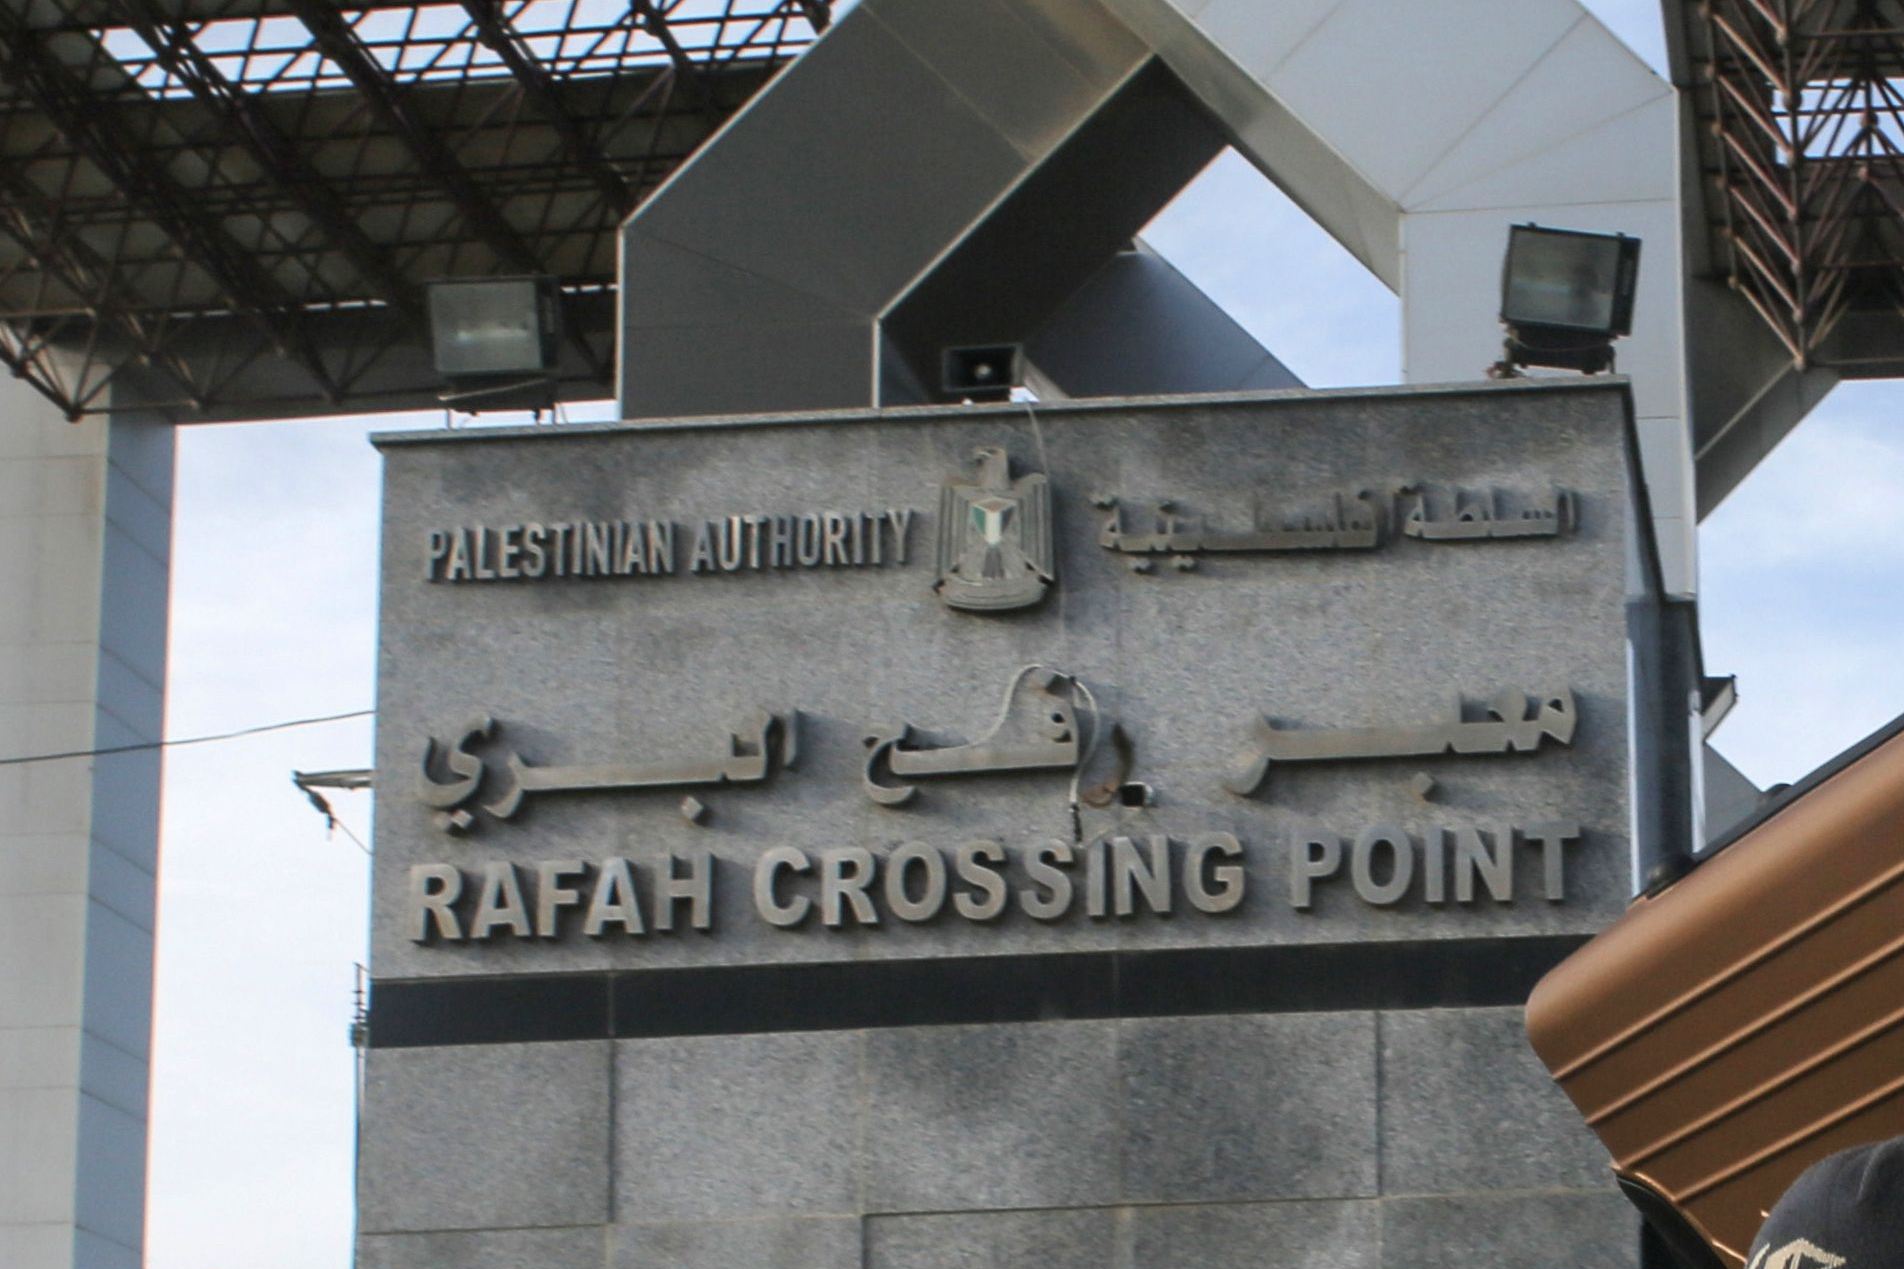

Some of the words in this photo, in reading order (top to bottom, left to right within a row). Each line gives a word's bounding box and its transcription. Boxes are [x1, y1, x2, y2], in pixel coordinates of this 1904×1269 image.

[426, 519, 678, 582] PALESTINIAN
[690, 508, 915, 574] AUTHORITY
[1397, 485, 1577, 540] السلطة
[420, 708, 801, 834] البري
[862, 672, 1137, 808] رفح
[1222, 685, 1577, 800] معبر
[409, 851, 714, 942] RAFAH
[753, 830, 1246, 928] CROSSING
[1290, 821, 1582, 909] POINT
